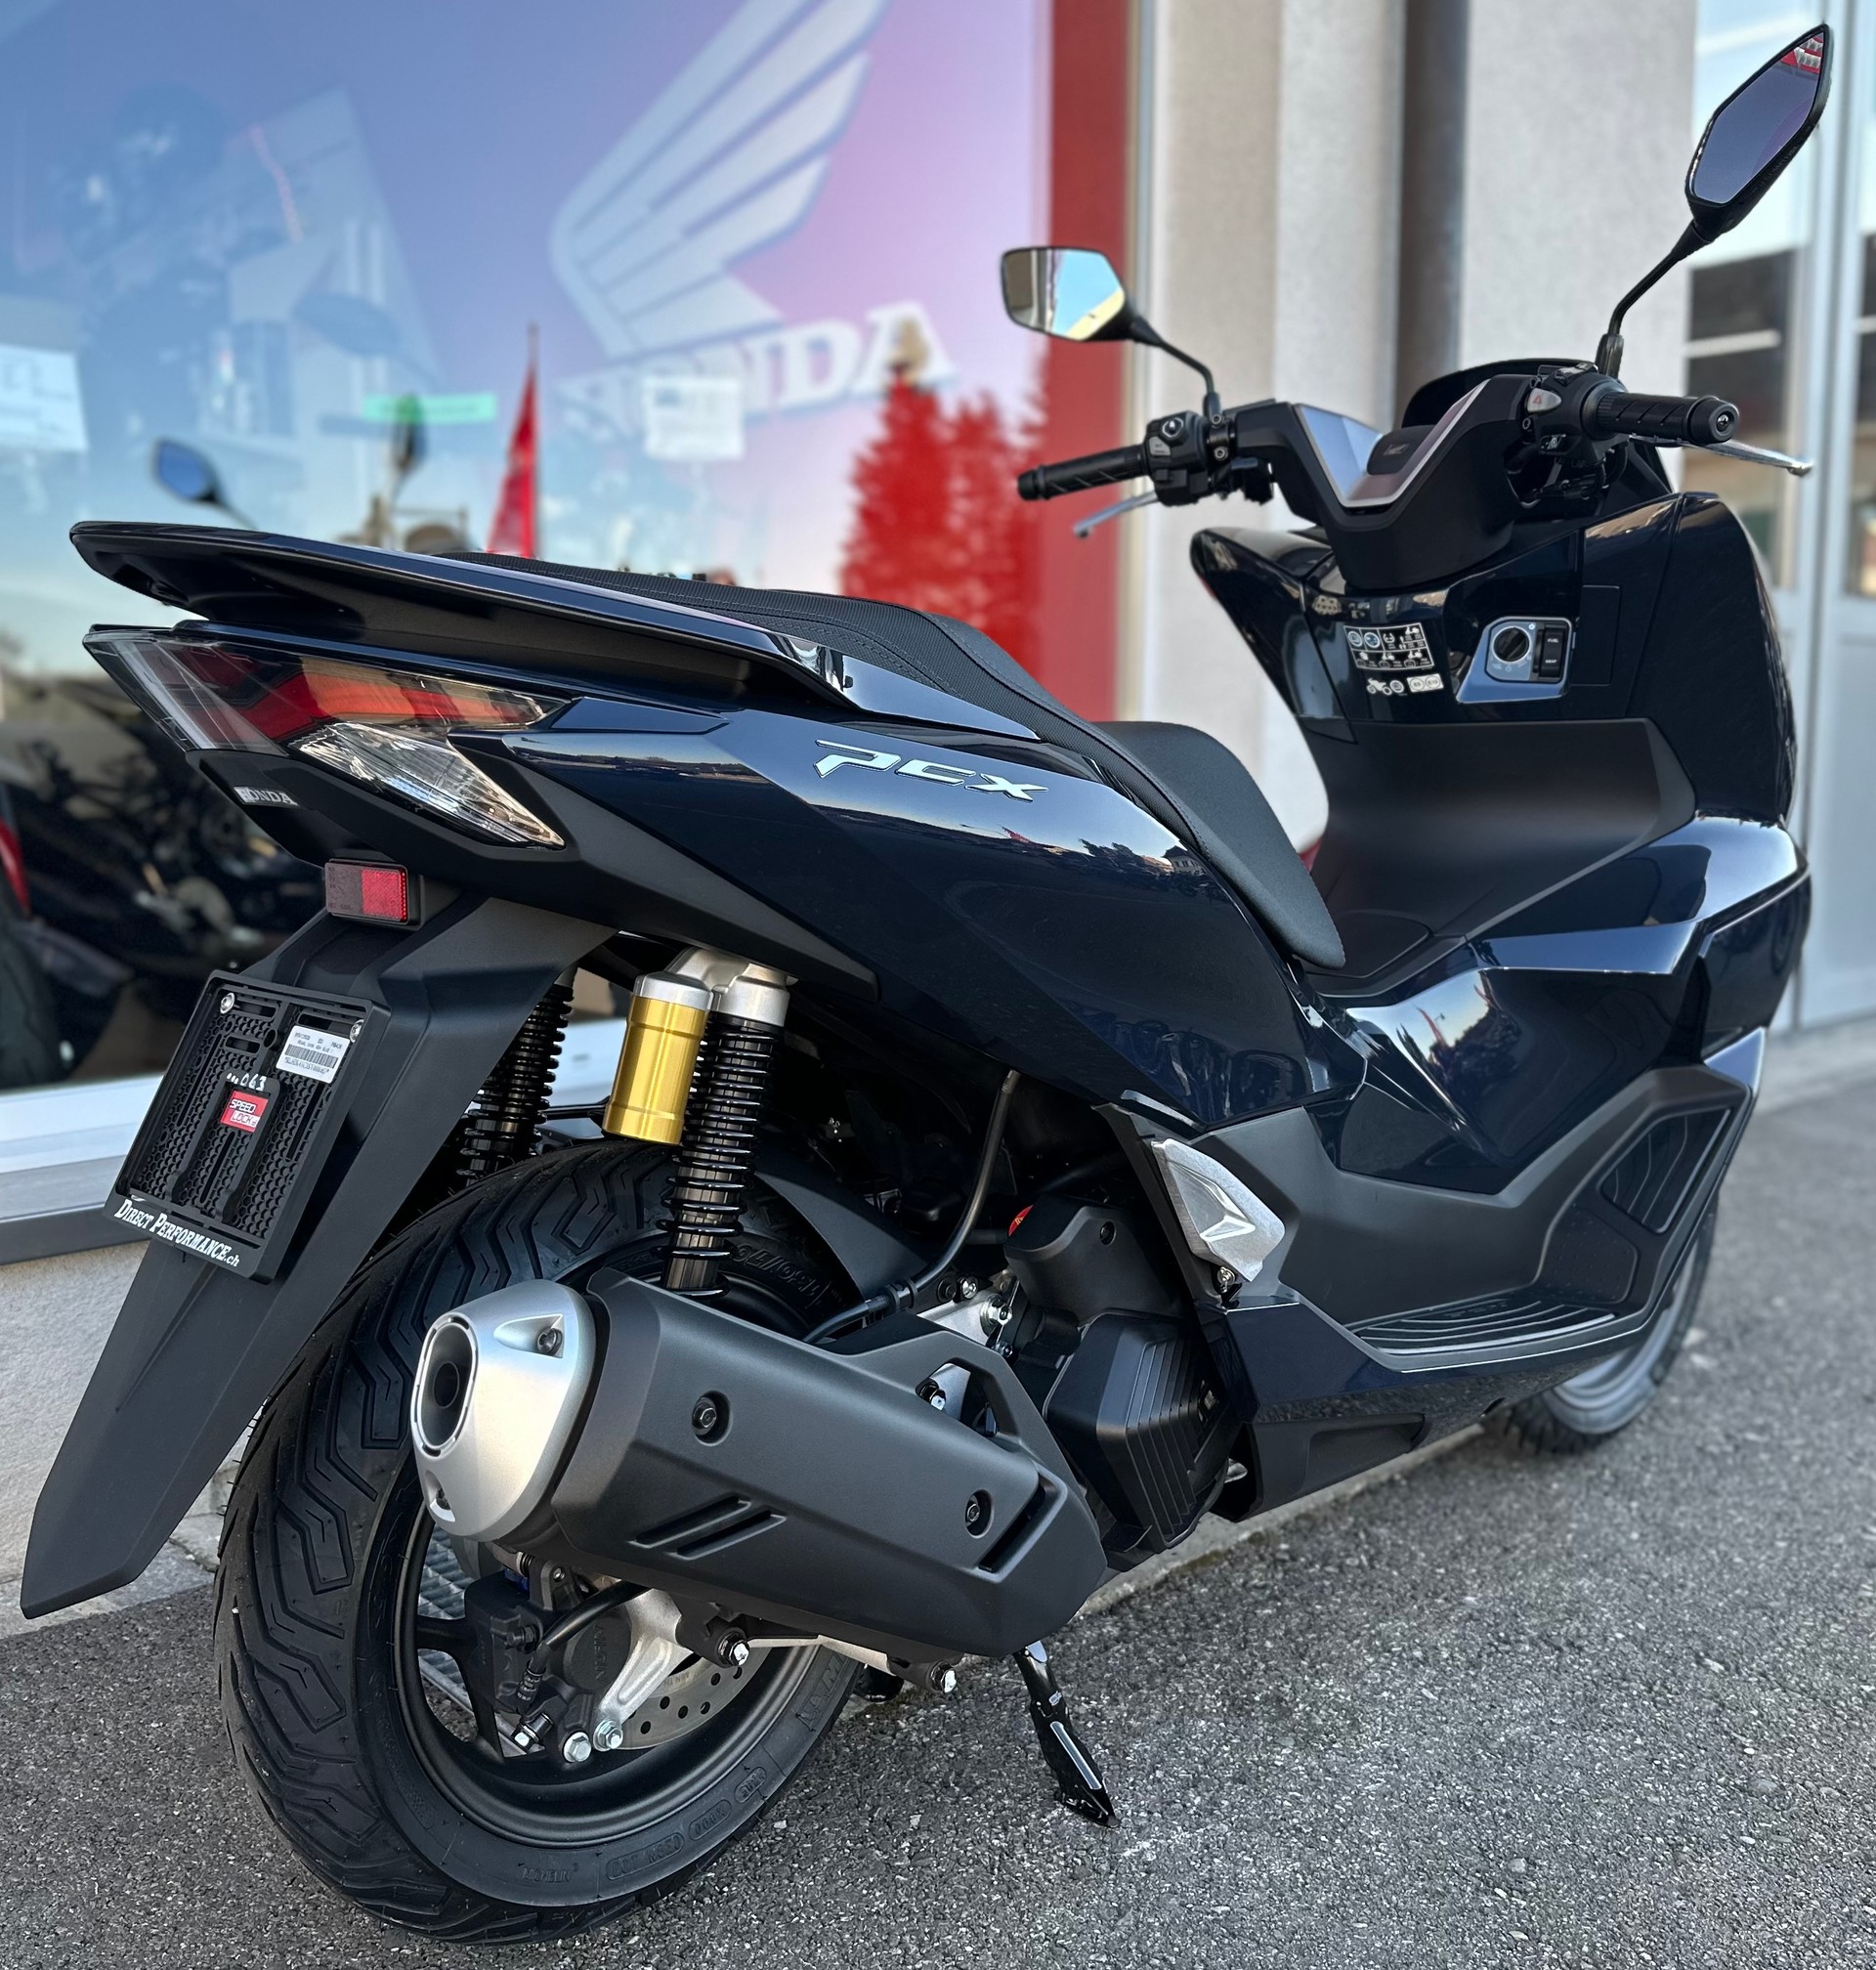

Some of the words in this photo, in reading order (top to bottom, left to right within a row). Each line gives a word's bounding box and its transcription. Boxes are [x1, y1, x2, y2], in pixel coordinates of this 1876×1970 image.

[812, 739, 1049, 803] PCX
[234, 786, 299, 806] HONDA
[229, 1098, 257, 1113] SPEED
[114, 1199, 154, 1229] DIRECT
